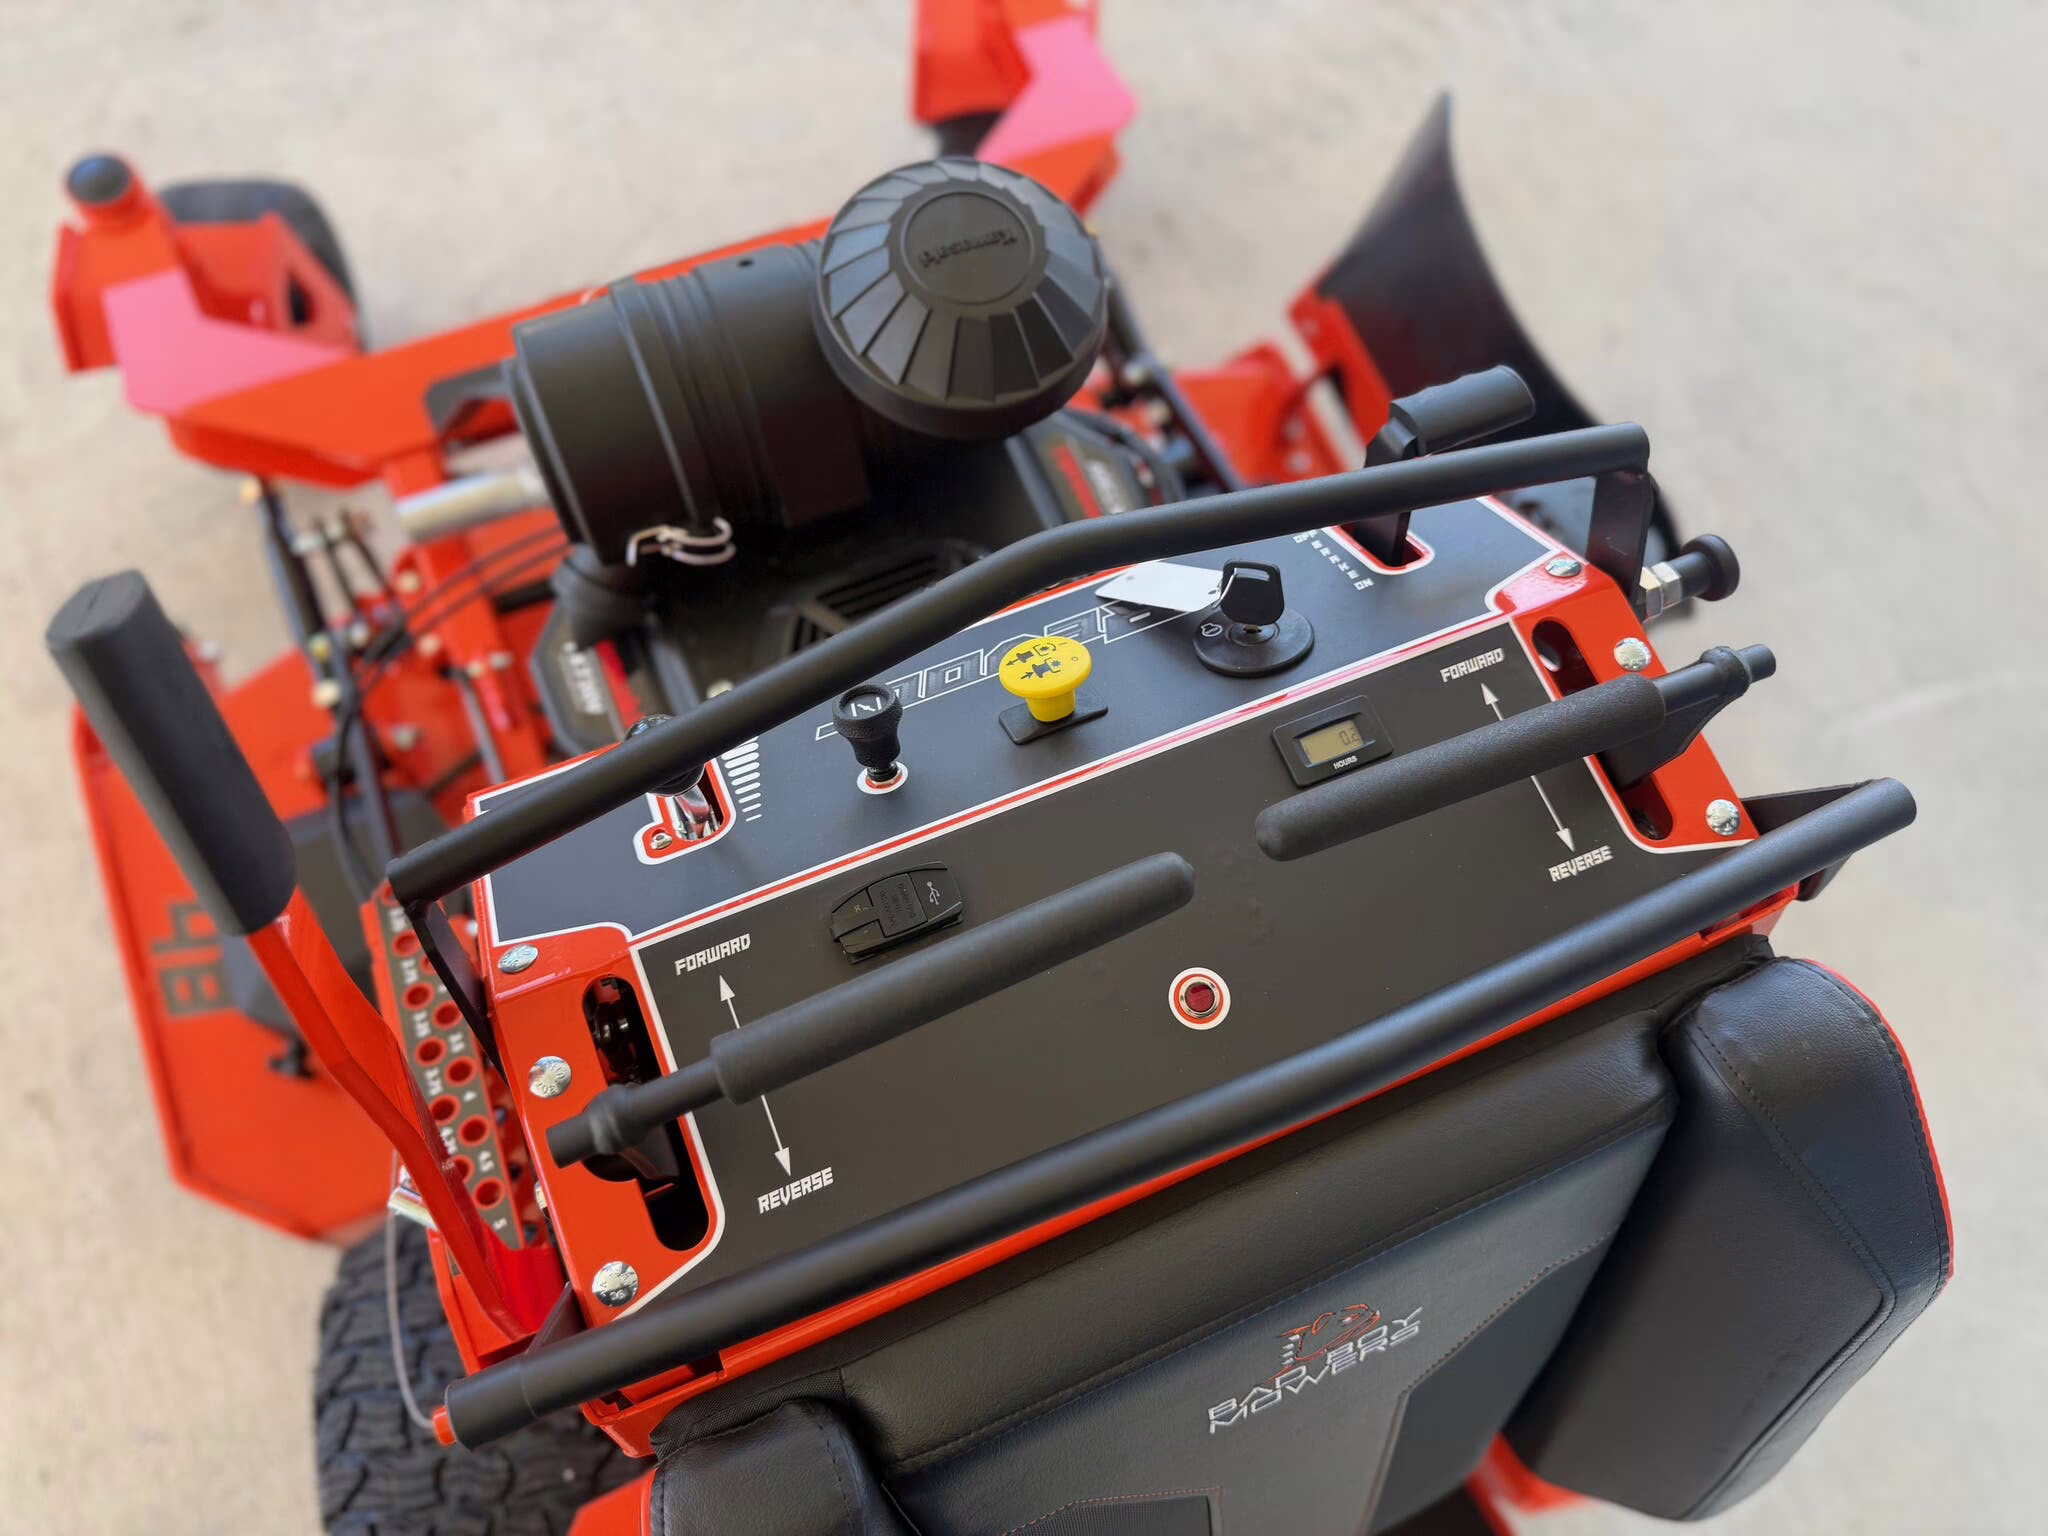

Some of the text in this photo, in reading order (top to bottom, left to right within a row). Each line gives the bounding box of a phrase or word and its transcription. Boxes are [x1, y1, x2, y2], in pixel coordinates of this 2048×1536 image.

[1354, 578, 1375, 591] ON
[1440, 647, 1505, 682] FORWARD
[1333, 755, 1358, 769] HOURS
[1548, 845, 1613, 882] REVERSE
[674, 933, 750, 976] FORWARD
[757, 1166, 834, 1214] REVERSE
[1208, 1306, 1423, 1420] BAD BOY
[1208, 1320, 1421, 1434] MOWERS
